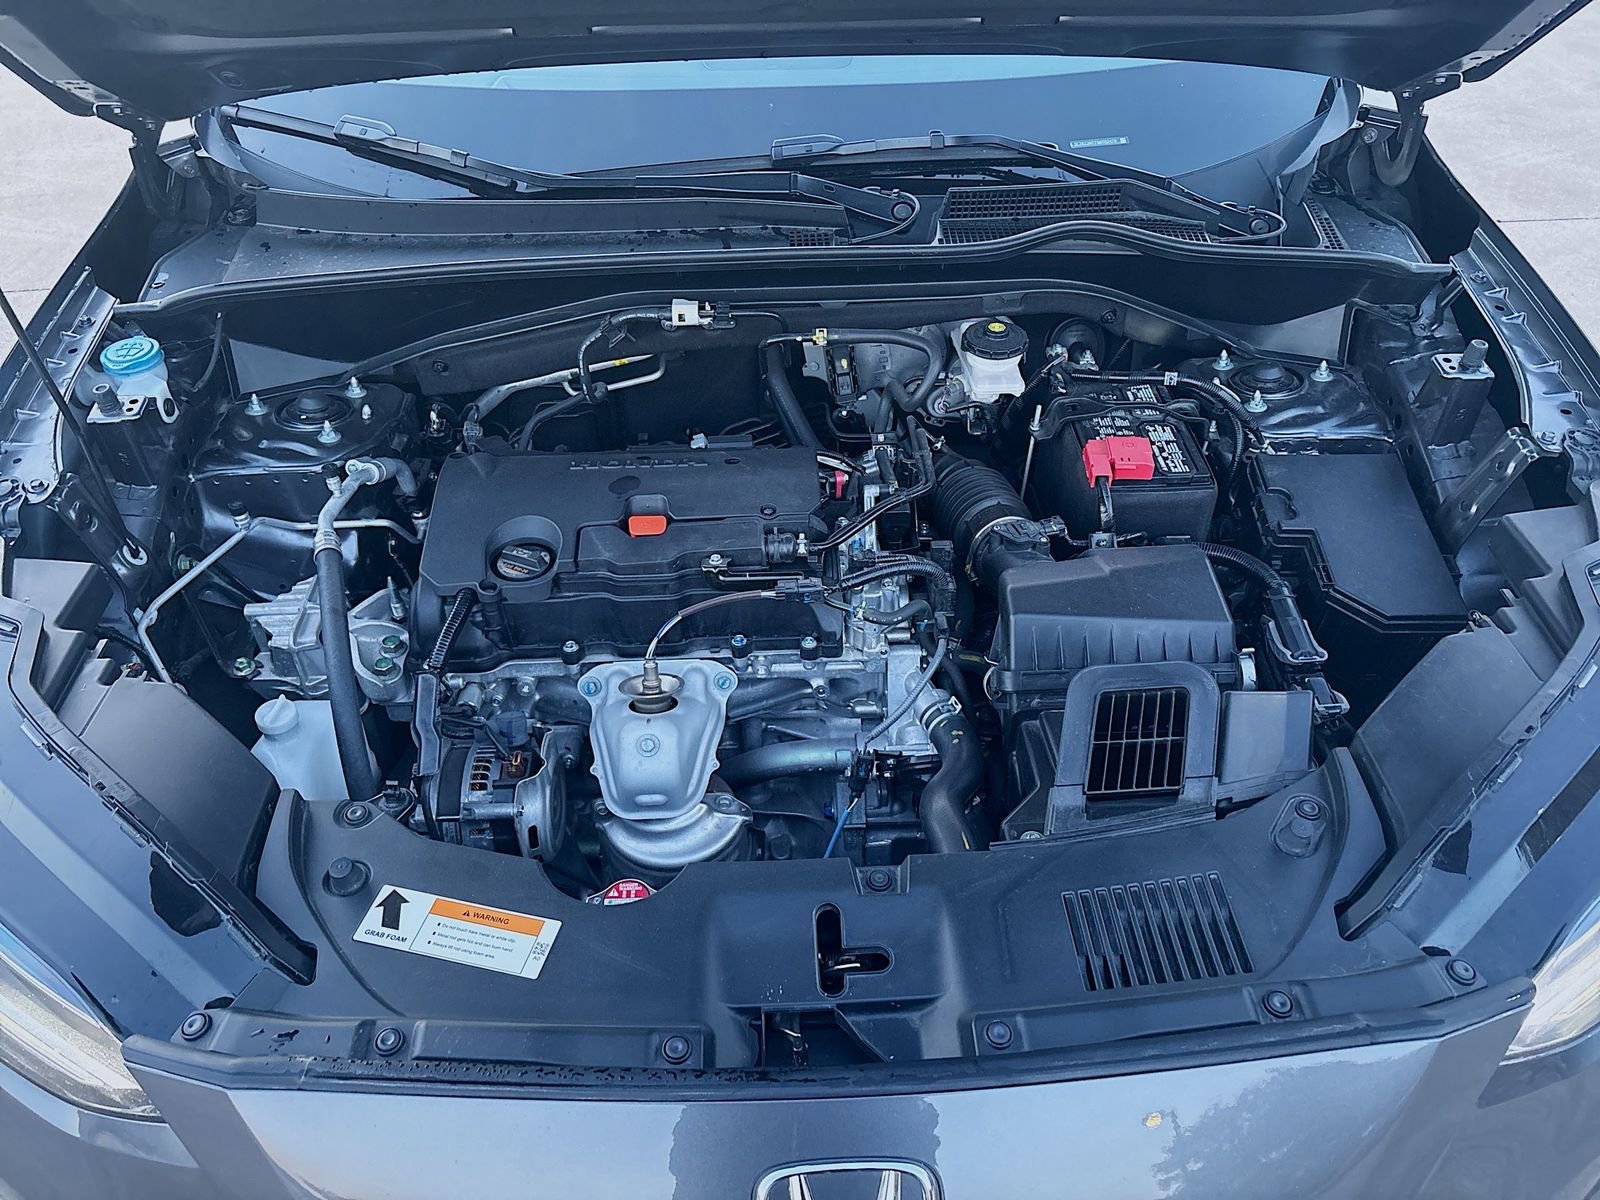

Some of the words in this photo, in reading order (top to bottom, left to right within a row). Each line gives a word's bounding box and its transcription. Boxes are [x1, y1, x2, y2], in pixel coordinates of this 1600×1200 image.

[569, 459, 708, 470] HONDA
[473, 911, 510, 925] WARNING
[365, 929, 385, 938] GRAB
[386, 934, 407, 942] FOAM
